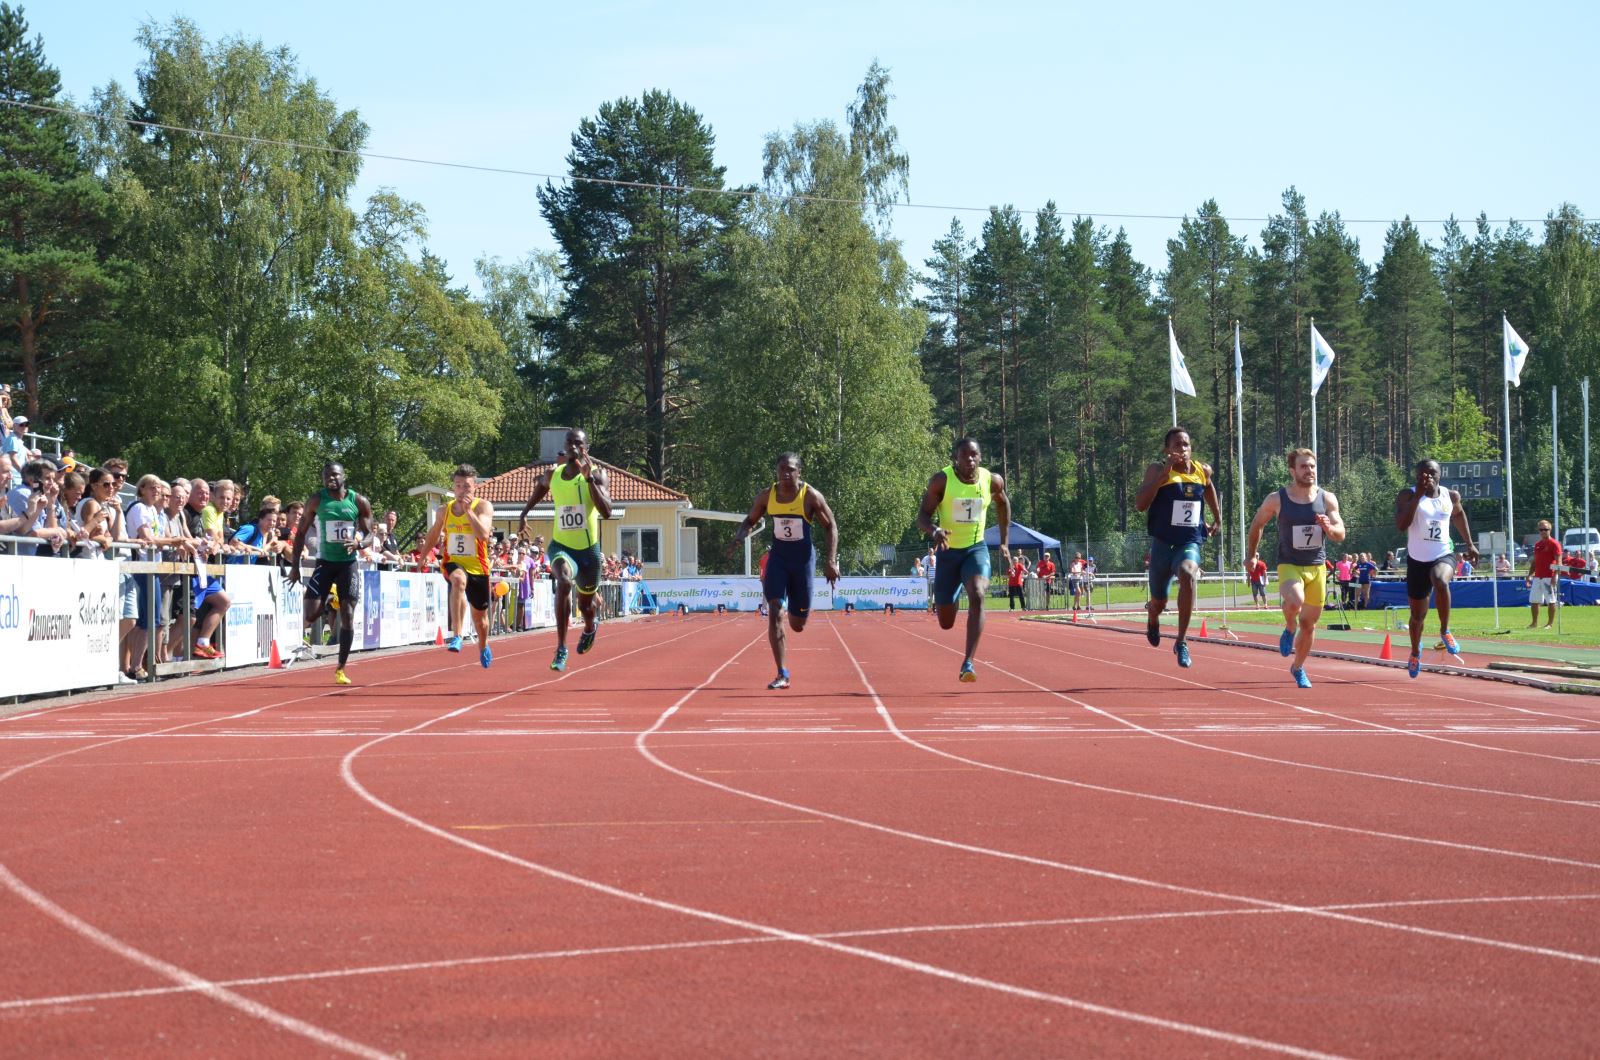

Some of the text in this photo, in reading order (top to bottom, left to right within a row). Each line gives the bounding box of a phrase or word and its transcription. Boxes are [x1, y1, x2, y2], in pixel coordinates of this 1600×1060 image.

[560, 512, 583, 527] 100
[966, 507, 972, 520] 1
[1184, 510, 1192, 522] 2
[784, 526, 792, 538] 3
[1428, 527, 1442, 539] 12
[1304, 533, 1313, 546] 7
[457, 542, 465, 553] 5
[838, 587, 923, 597] sundsvallsflyg.se
[27, 609, 72, 641] BRIDGESTONE
